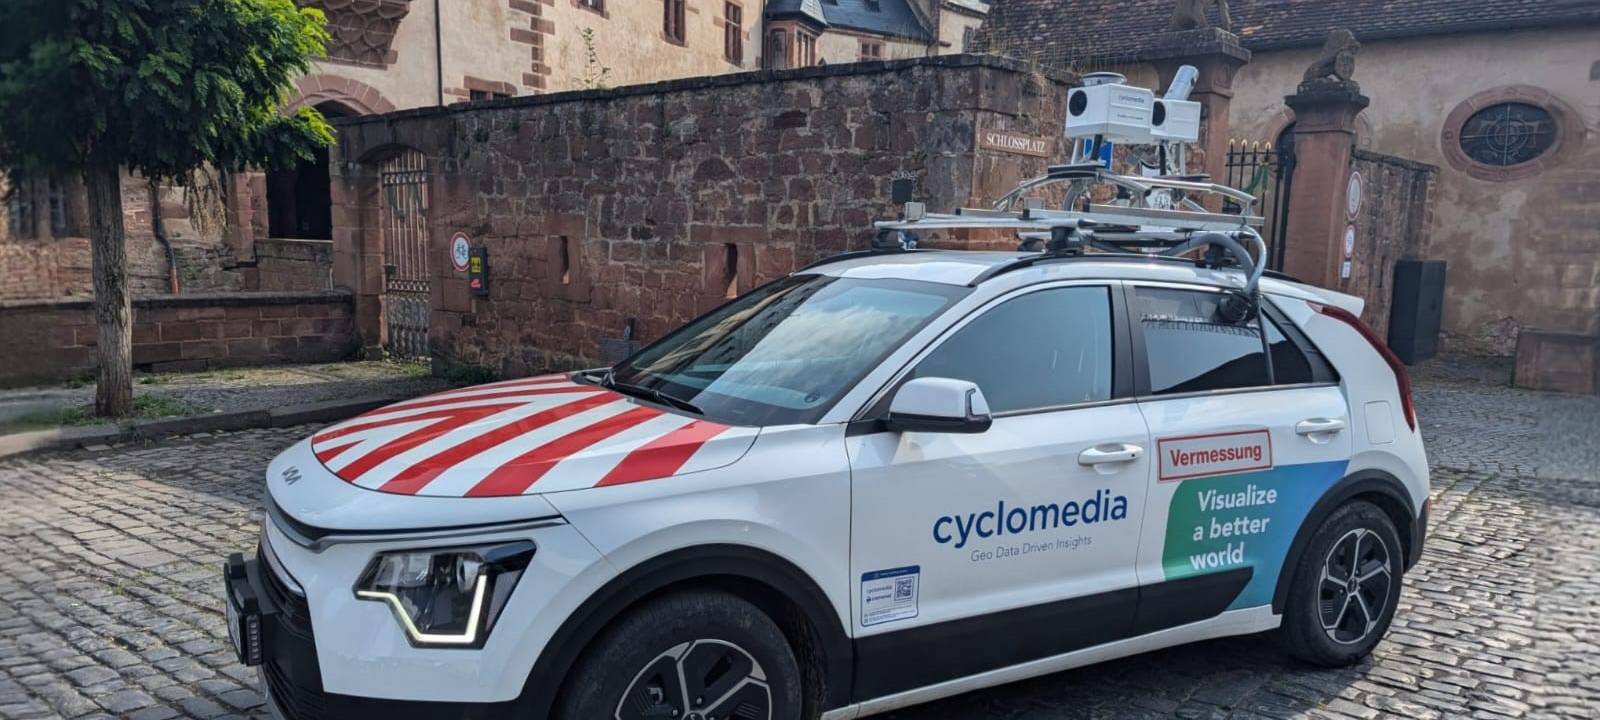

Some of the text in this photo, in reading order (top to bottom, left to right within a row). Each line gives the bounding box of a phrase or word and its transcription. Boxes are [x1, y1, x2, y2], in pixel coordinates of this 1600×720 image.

[986, 132, 1046, 153] SCHLOSSPLATZ
[1170, 445, 1262, 467] Vermessung
[1198, 484, 1278, 512] Visualize
[933, 489, 1128, 549] cyclomedia
[1193, 517, 1270, 541] a better
[970, 536, 1093, 562] Geo Data Driven Insights
[1190, 541, 1244, 571] world
